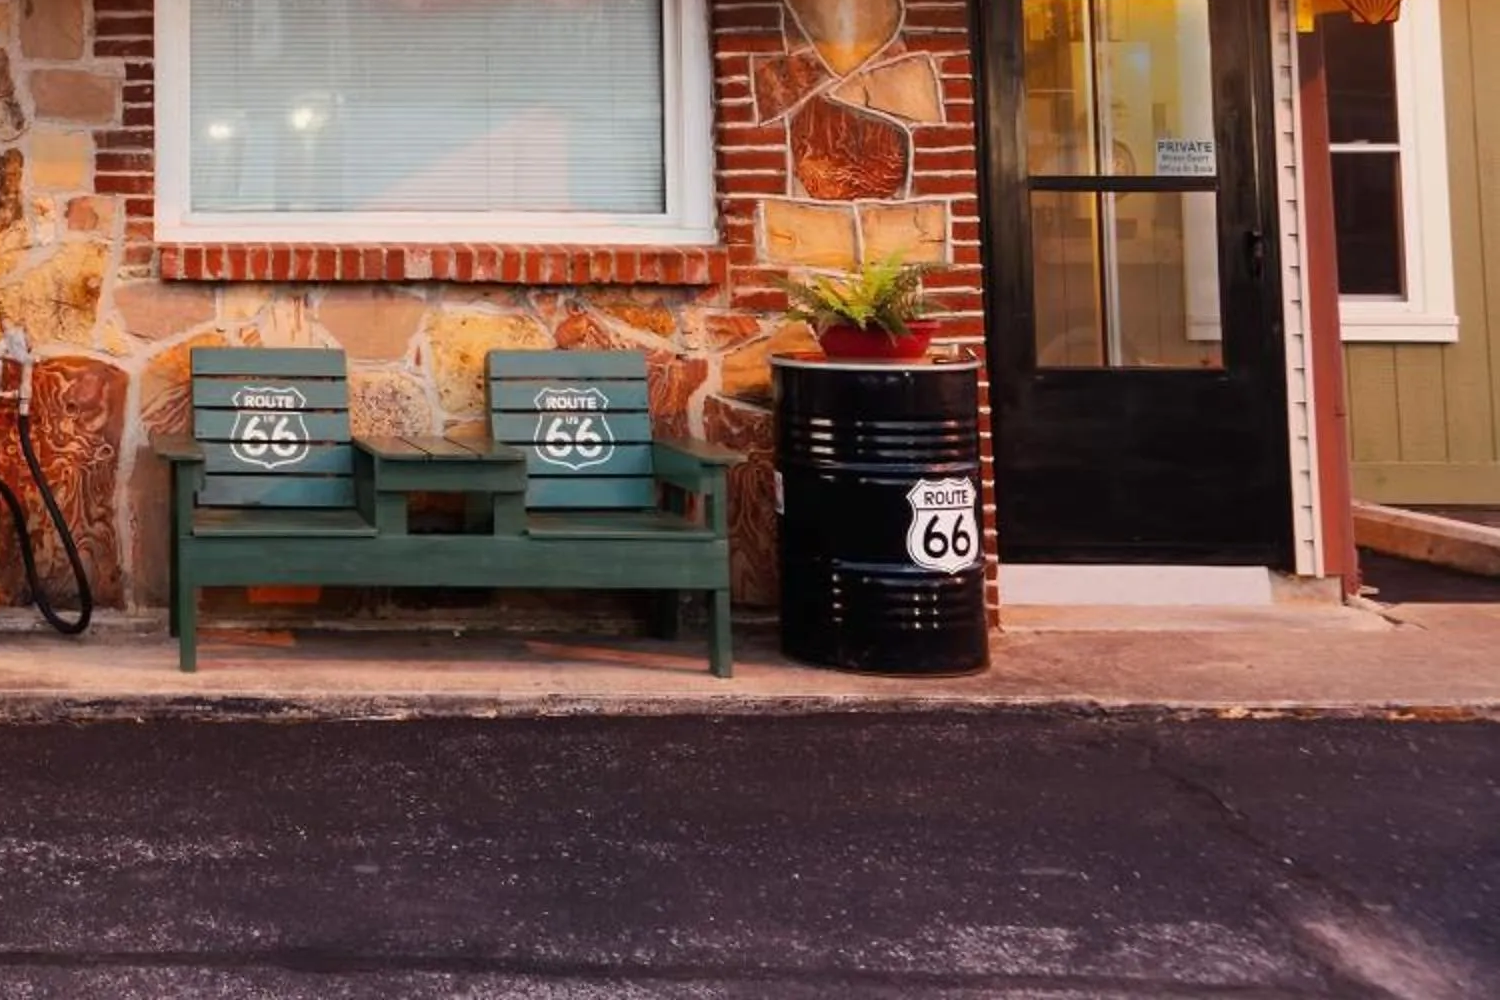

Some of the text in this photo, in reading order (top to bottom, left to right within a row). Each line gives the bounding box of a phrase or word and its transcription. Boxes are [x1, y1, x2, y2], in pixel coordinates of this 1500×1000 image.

[1157, 141, 1213, 153] PRIVATE
[243, 395, 295, 409] ROUTE
[545, 396, 598, 409] ROUTE
[242, 416, 298, 457] 66
[545, 417, 602, 457] 66
[923, 489, 969, 505] ROUTE
[923, 512, 971, 559] 66
